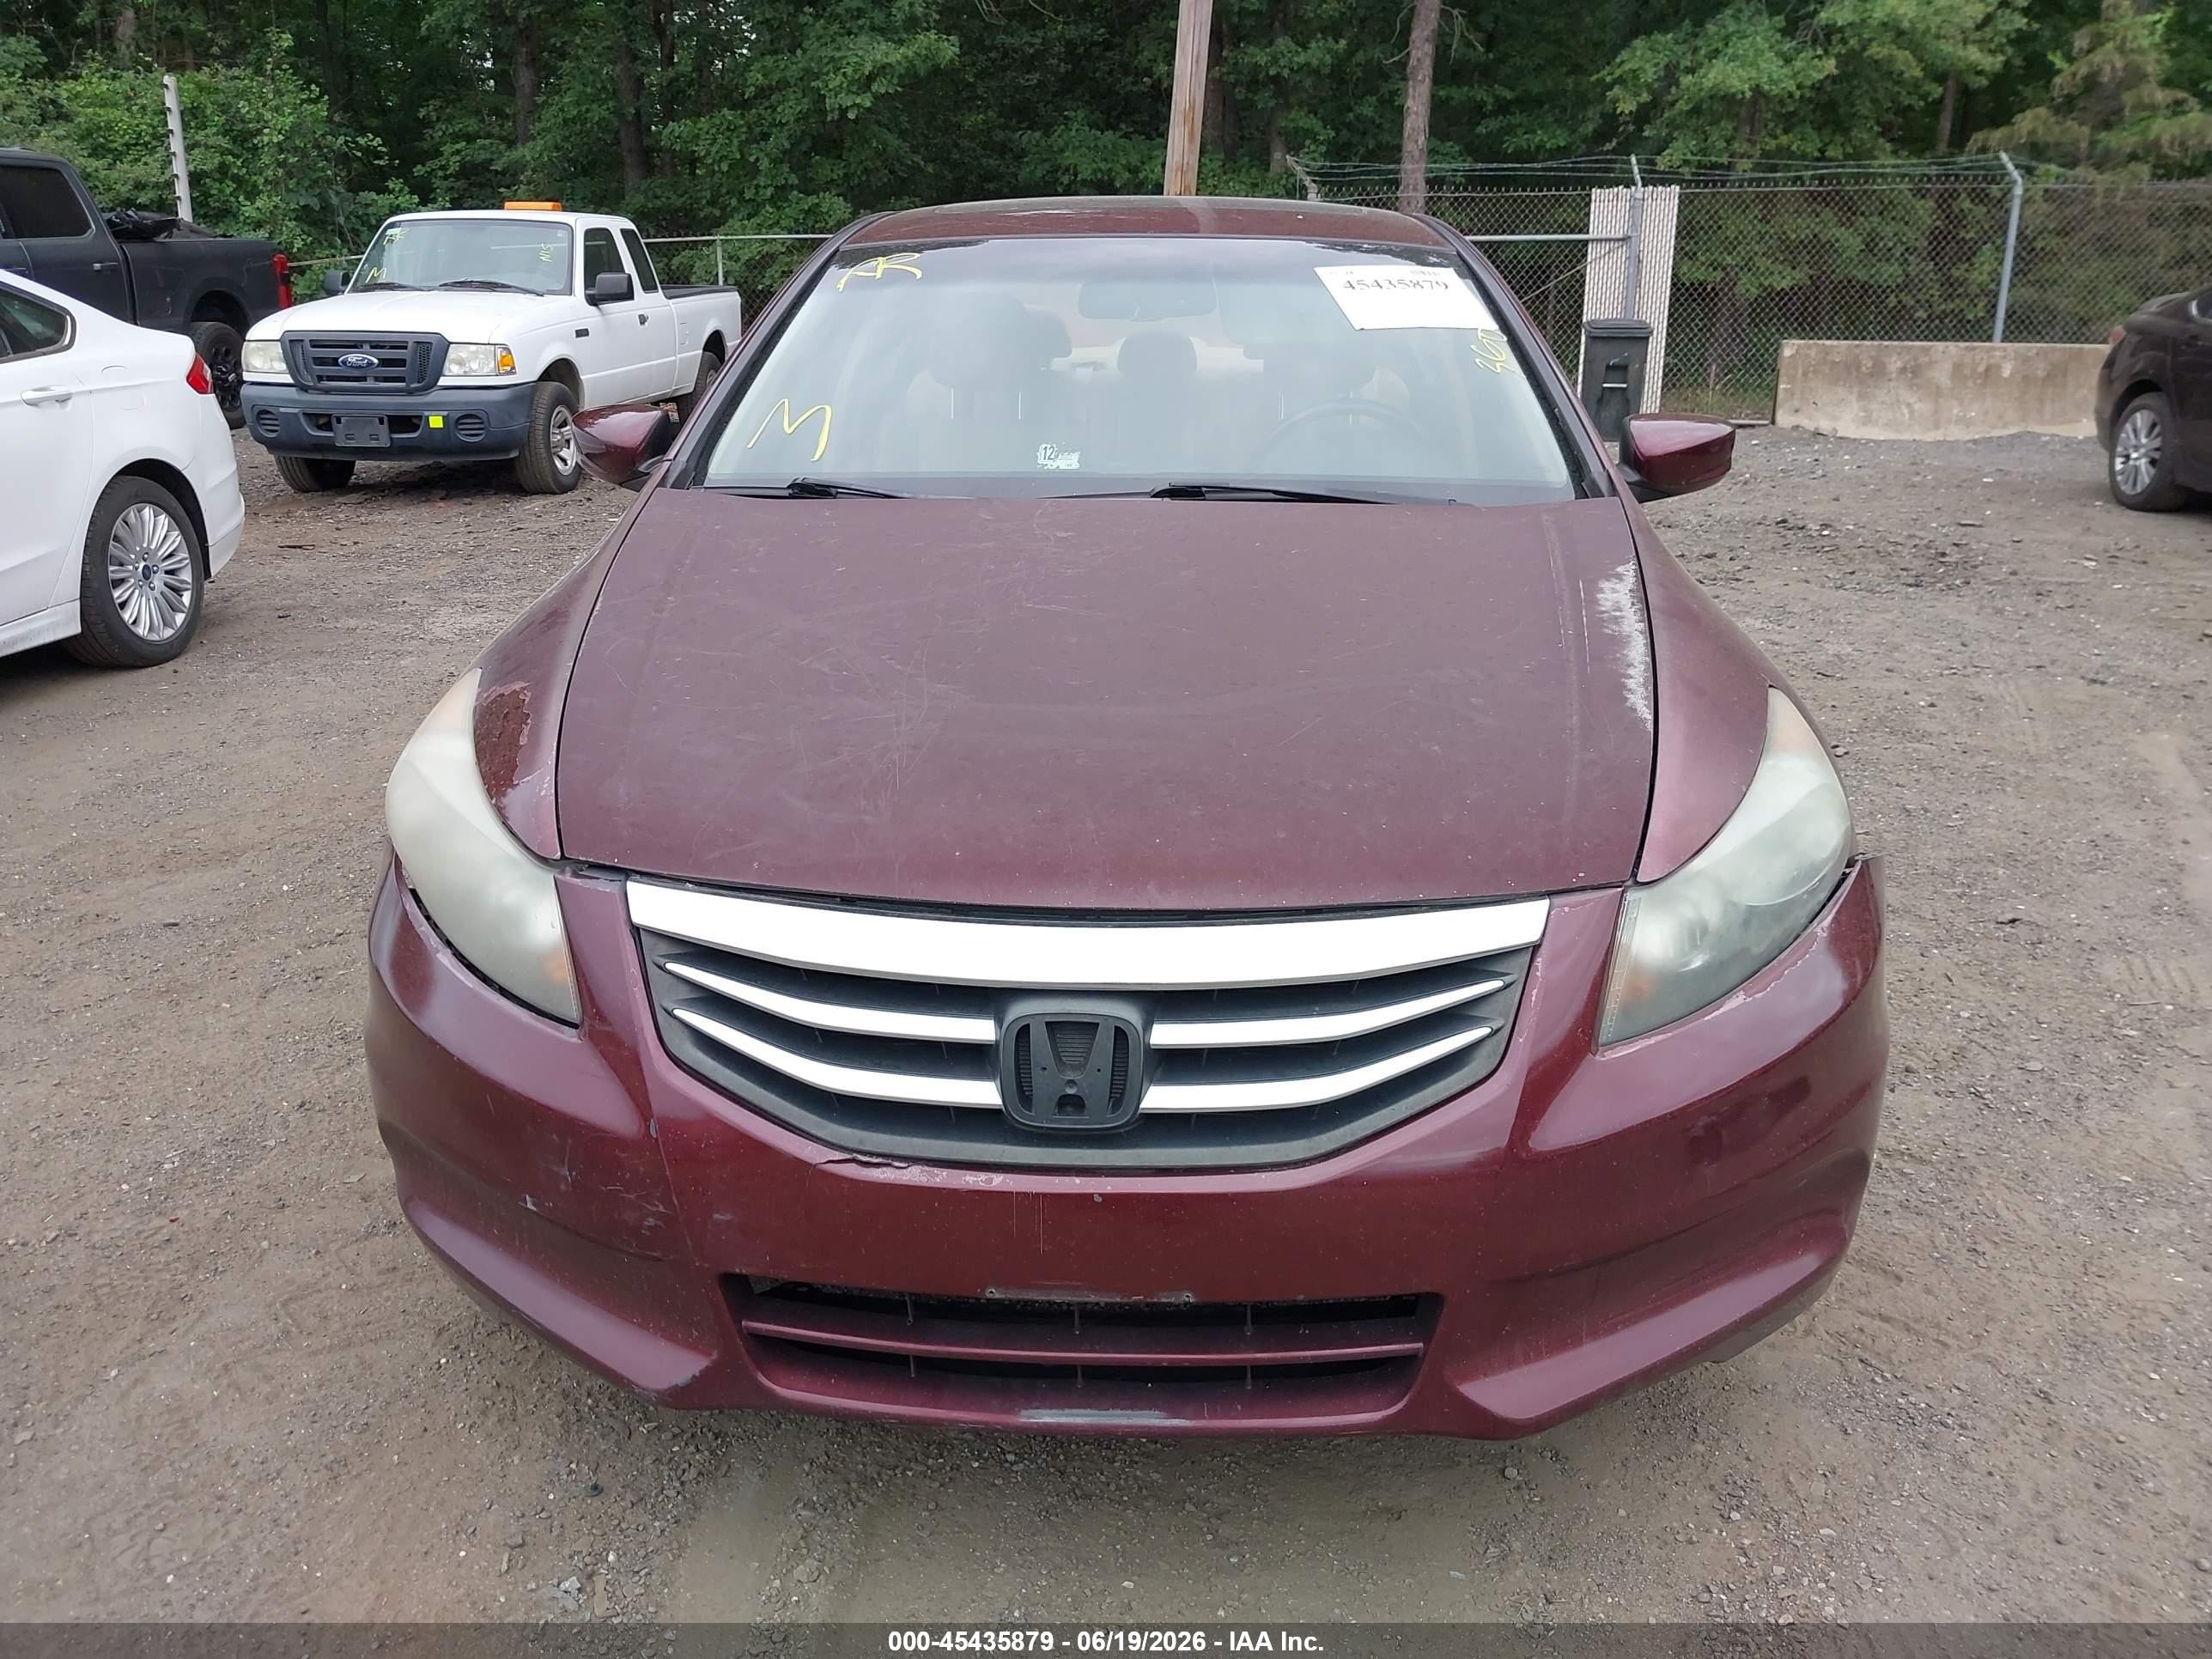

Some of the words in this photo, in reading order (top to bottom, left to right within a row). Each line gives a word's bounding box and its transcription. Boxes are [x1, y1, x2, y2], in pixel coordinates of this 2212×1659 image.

[365, 266, 387, 283] M
[1343, 278, 1449, 291] 45435879
[746, 398, 832, 462] M
[1042, 445, 1055, 461] 12
